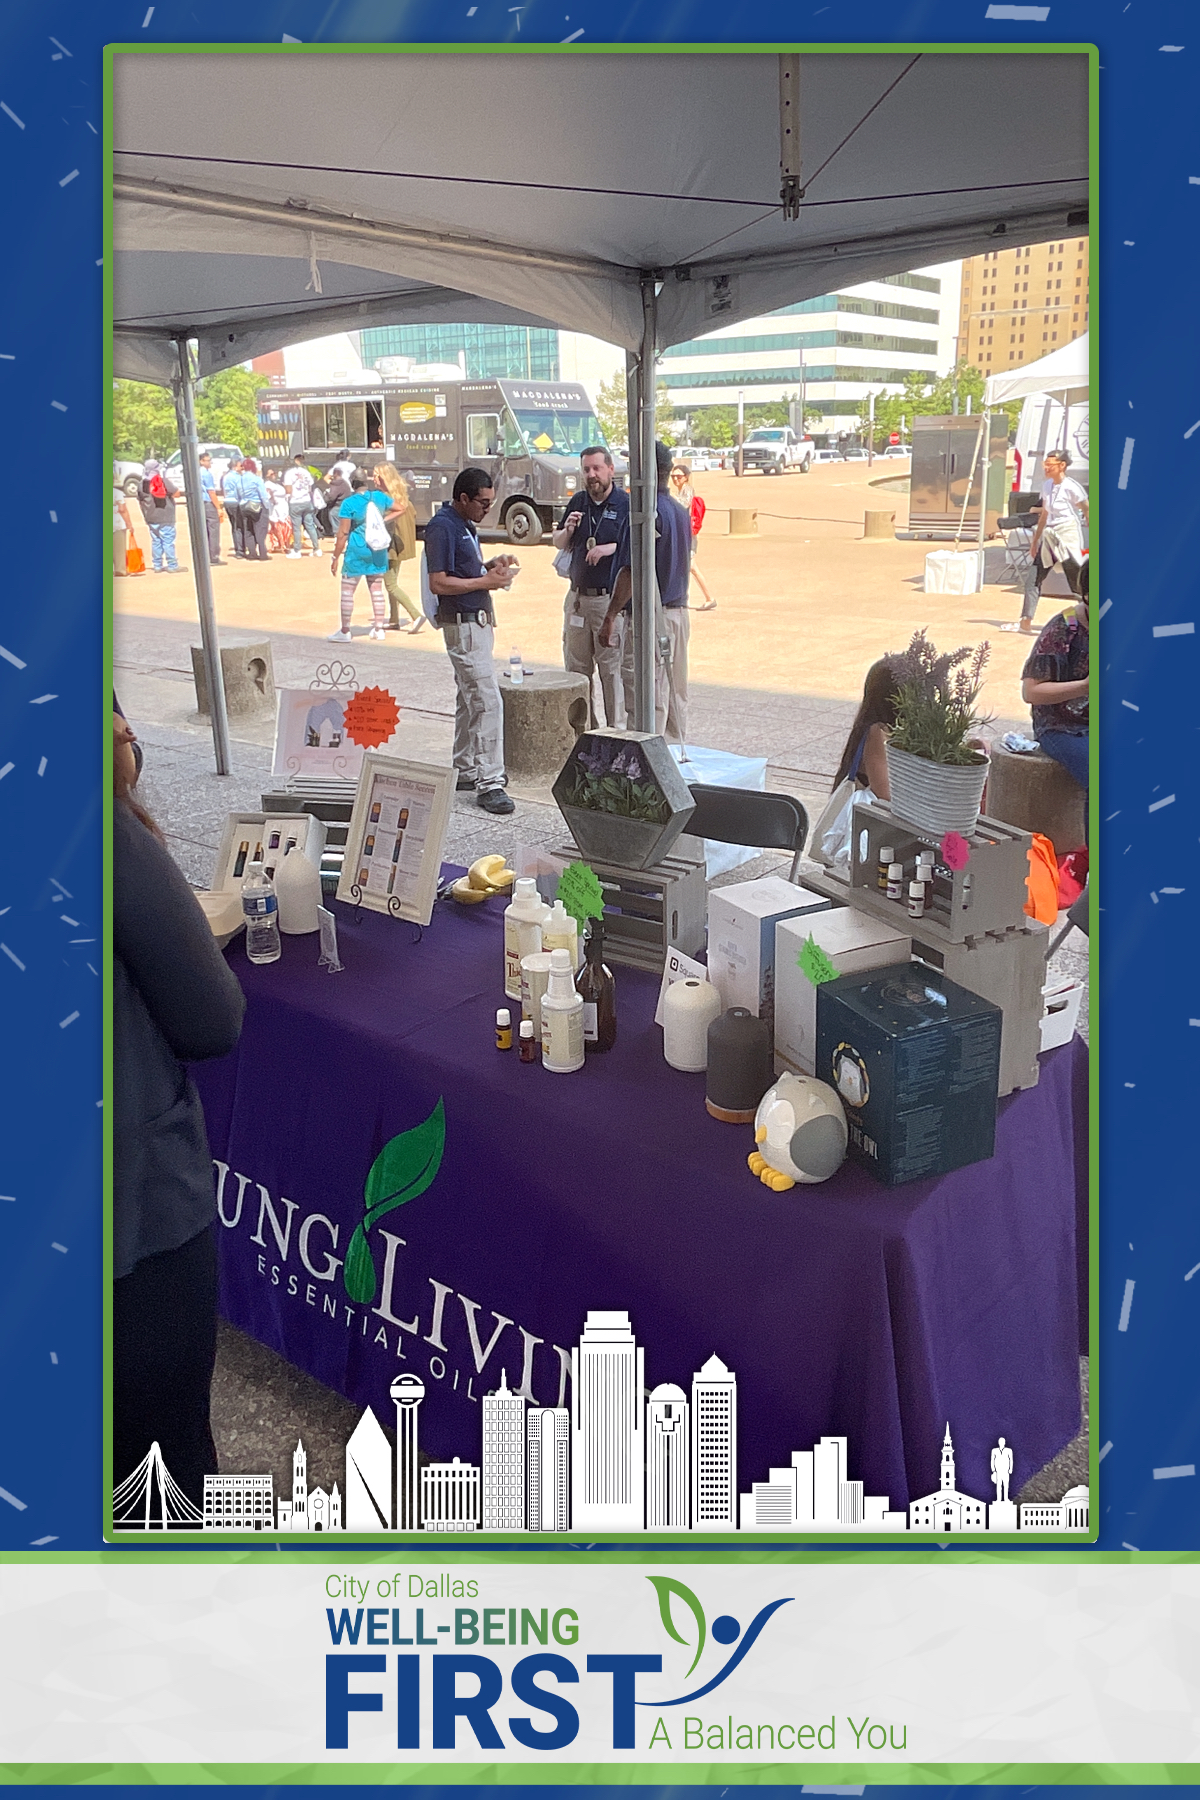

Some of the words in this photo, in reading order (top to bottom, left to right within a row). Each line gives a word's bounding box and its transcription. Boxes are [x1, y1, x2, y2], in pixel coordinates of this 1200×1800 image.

[513, 390, 582, 401] MAGDALENA'S
[533, 400, 550, 408] food
[390, 433, 454, 442] MAGDALENA'S
[213, 1159, 343, 1282] UNG
[371, 1228, 573, 1408] LIVI
[257, 1254, 407, 1360] ESSENTIAL
